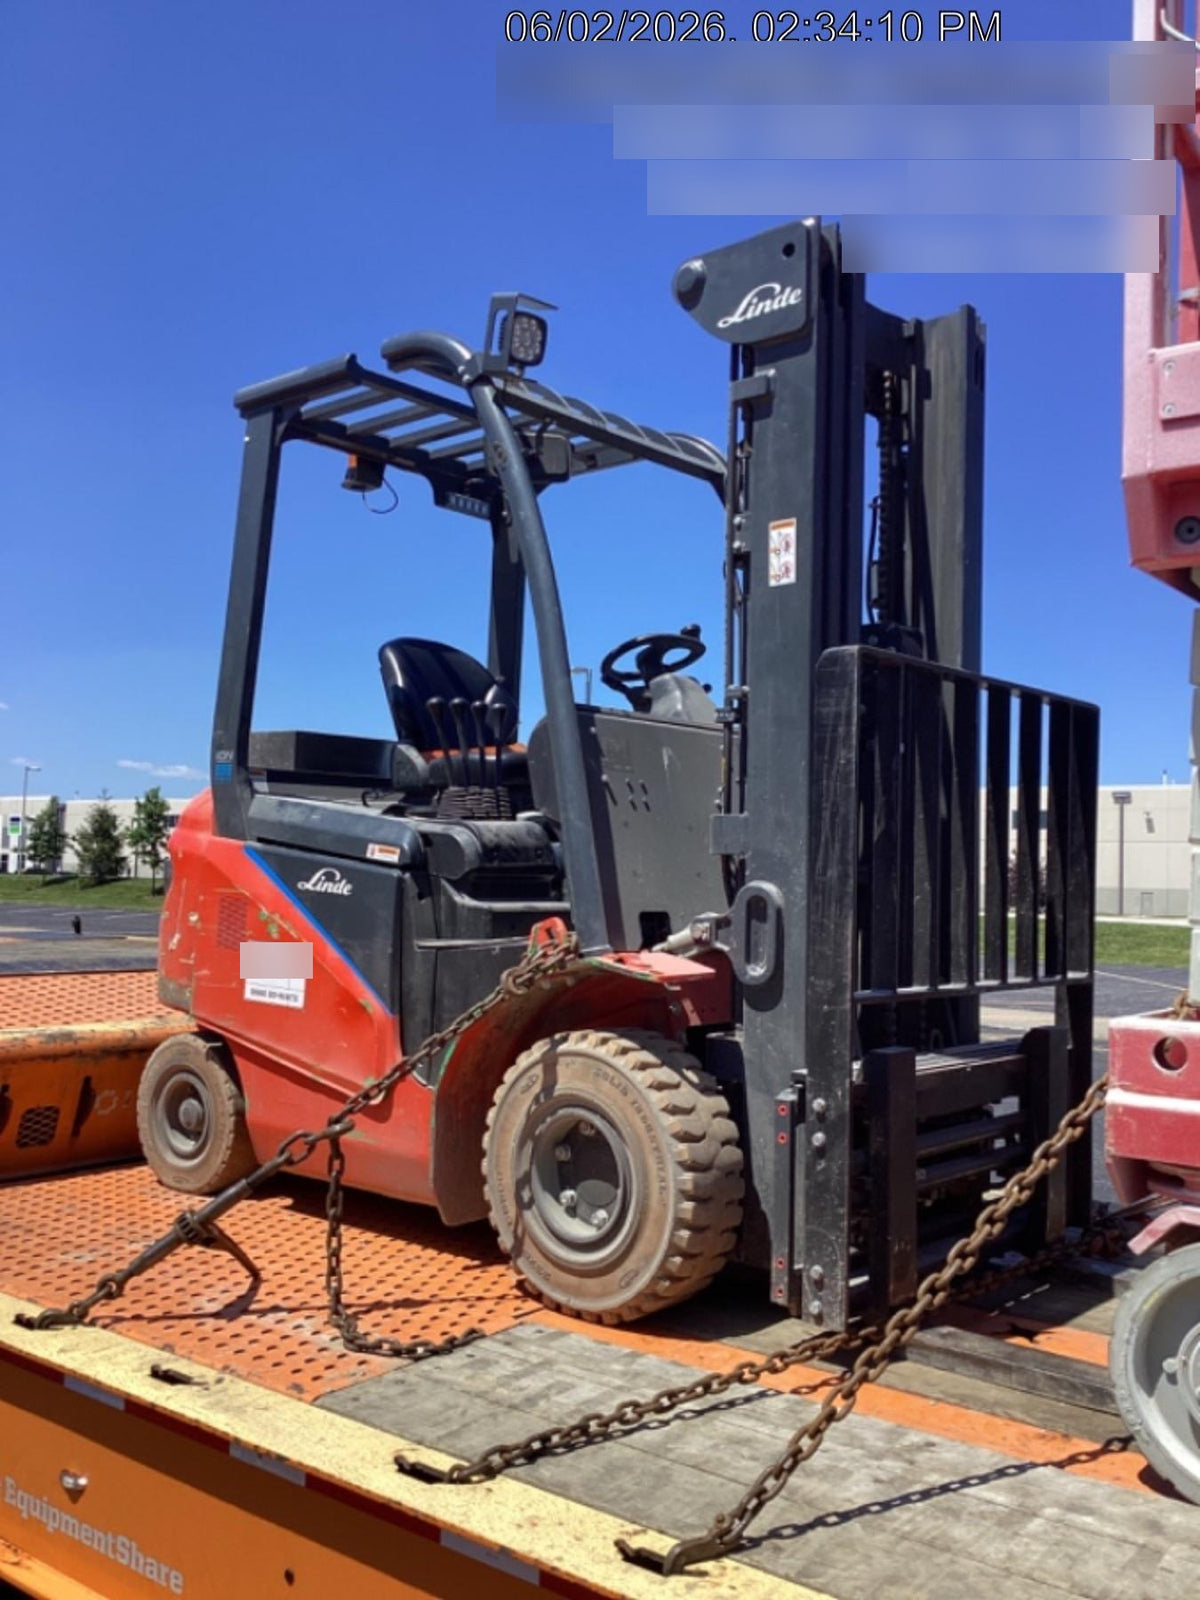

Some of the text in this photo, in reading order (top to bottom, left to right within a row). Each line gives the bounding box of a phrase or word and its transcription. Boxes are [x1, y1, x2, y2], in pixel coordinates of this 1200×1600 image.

[716, 282, 803, 329] Linde
[297, 867, 353, 896] Linde
[4, 1477, 184, 1594] EquipmentShare
